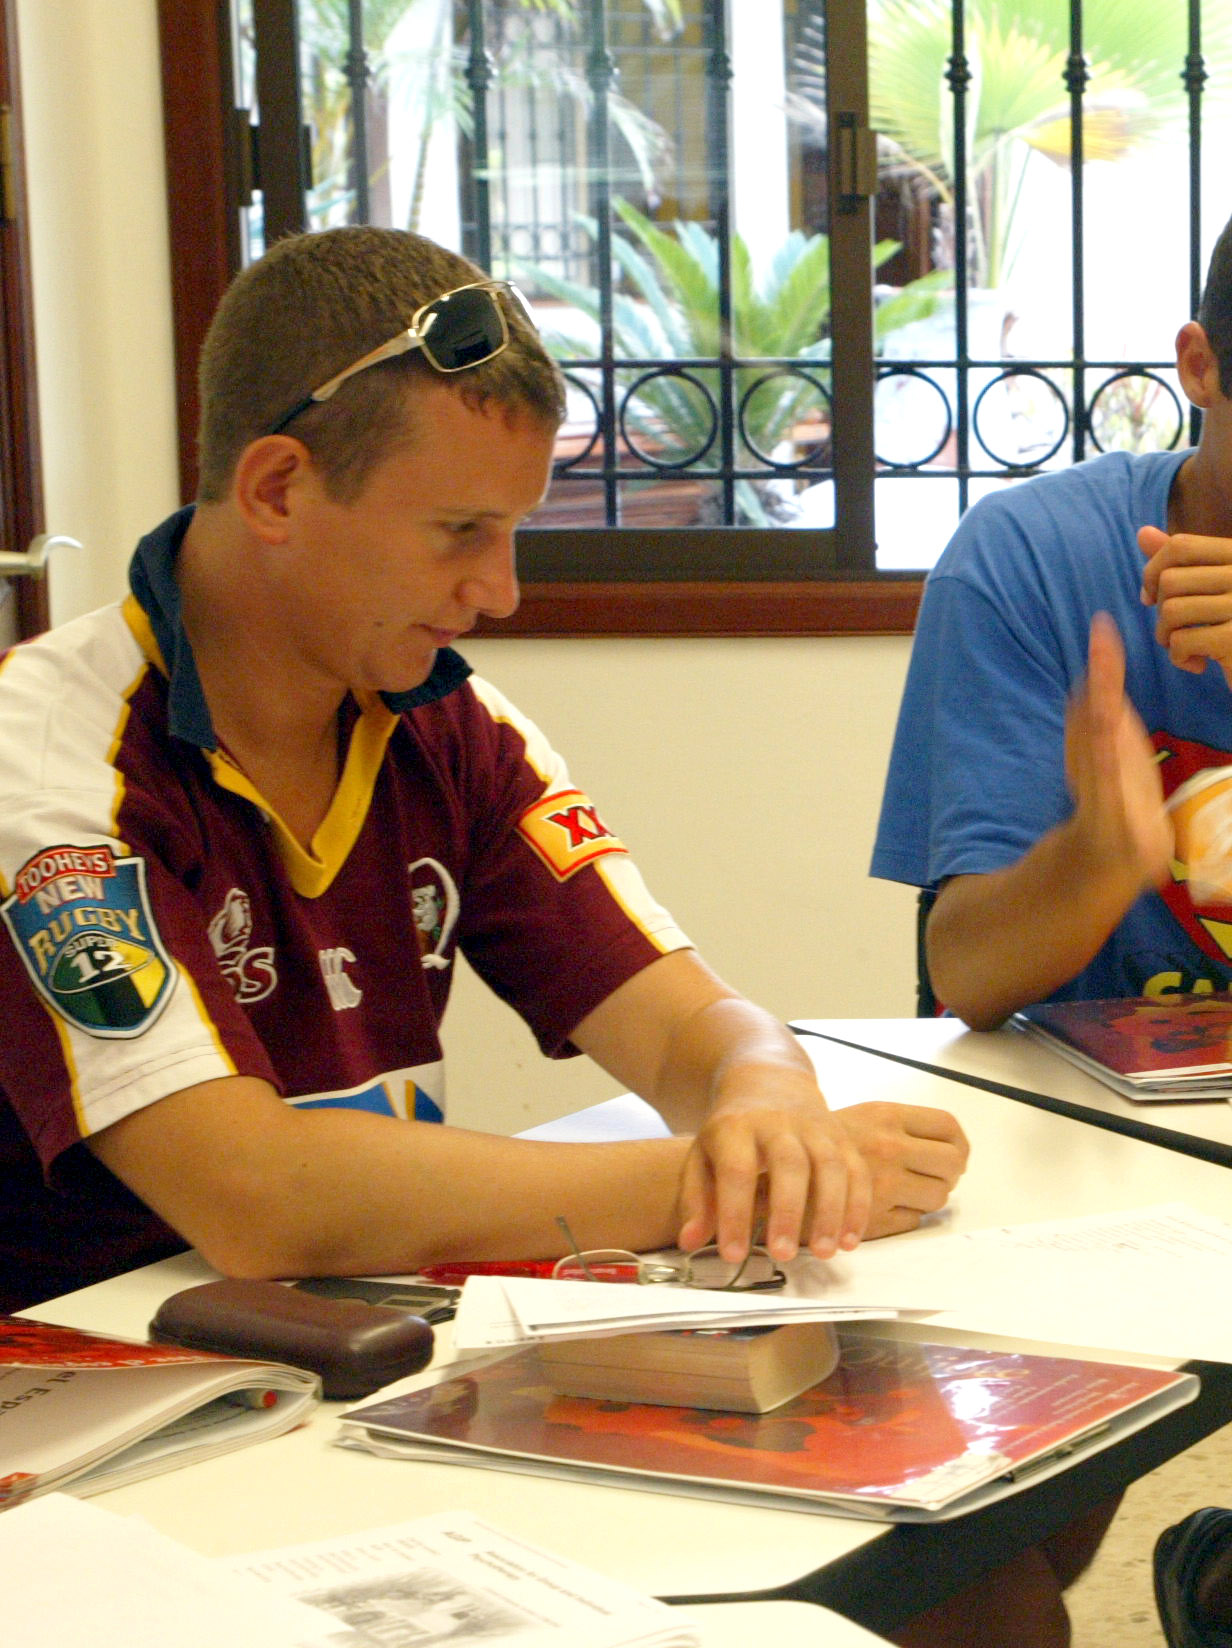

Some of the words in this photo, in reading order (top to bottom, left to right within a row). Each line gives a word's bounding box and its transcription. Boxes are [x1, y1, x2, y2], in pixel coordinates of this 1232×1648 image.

[19, 852, 110, 894] TOOHEYS
[34, 874, 105, 914] NEW
[28, 907, 146, 976] RUGBY
[70, 951, 134, 983] 12
